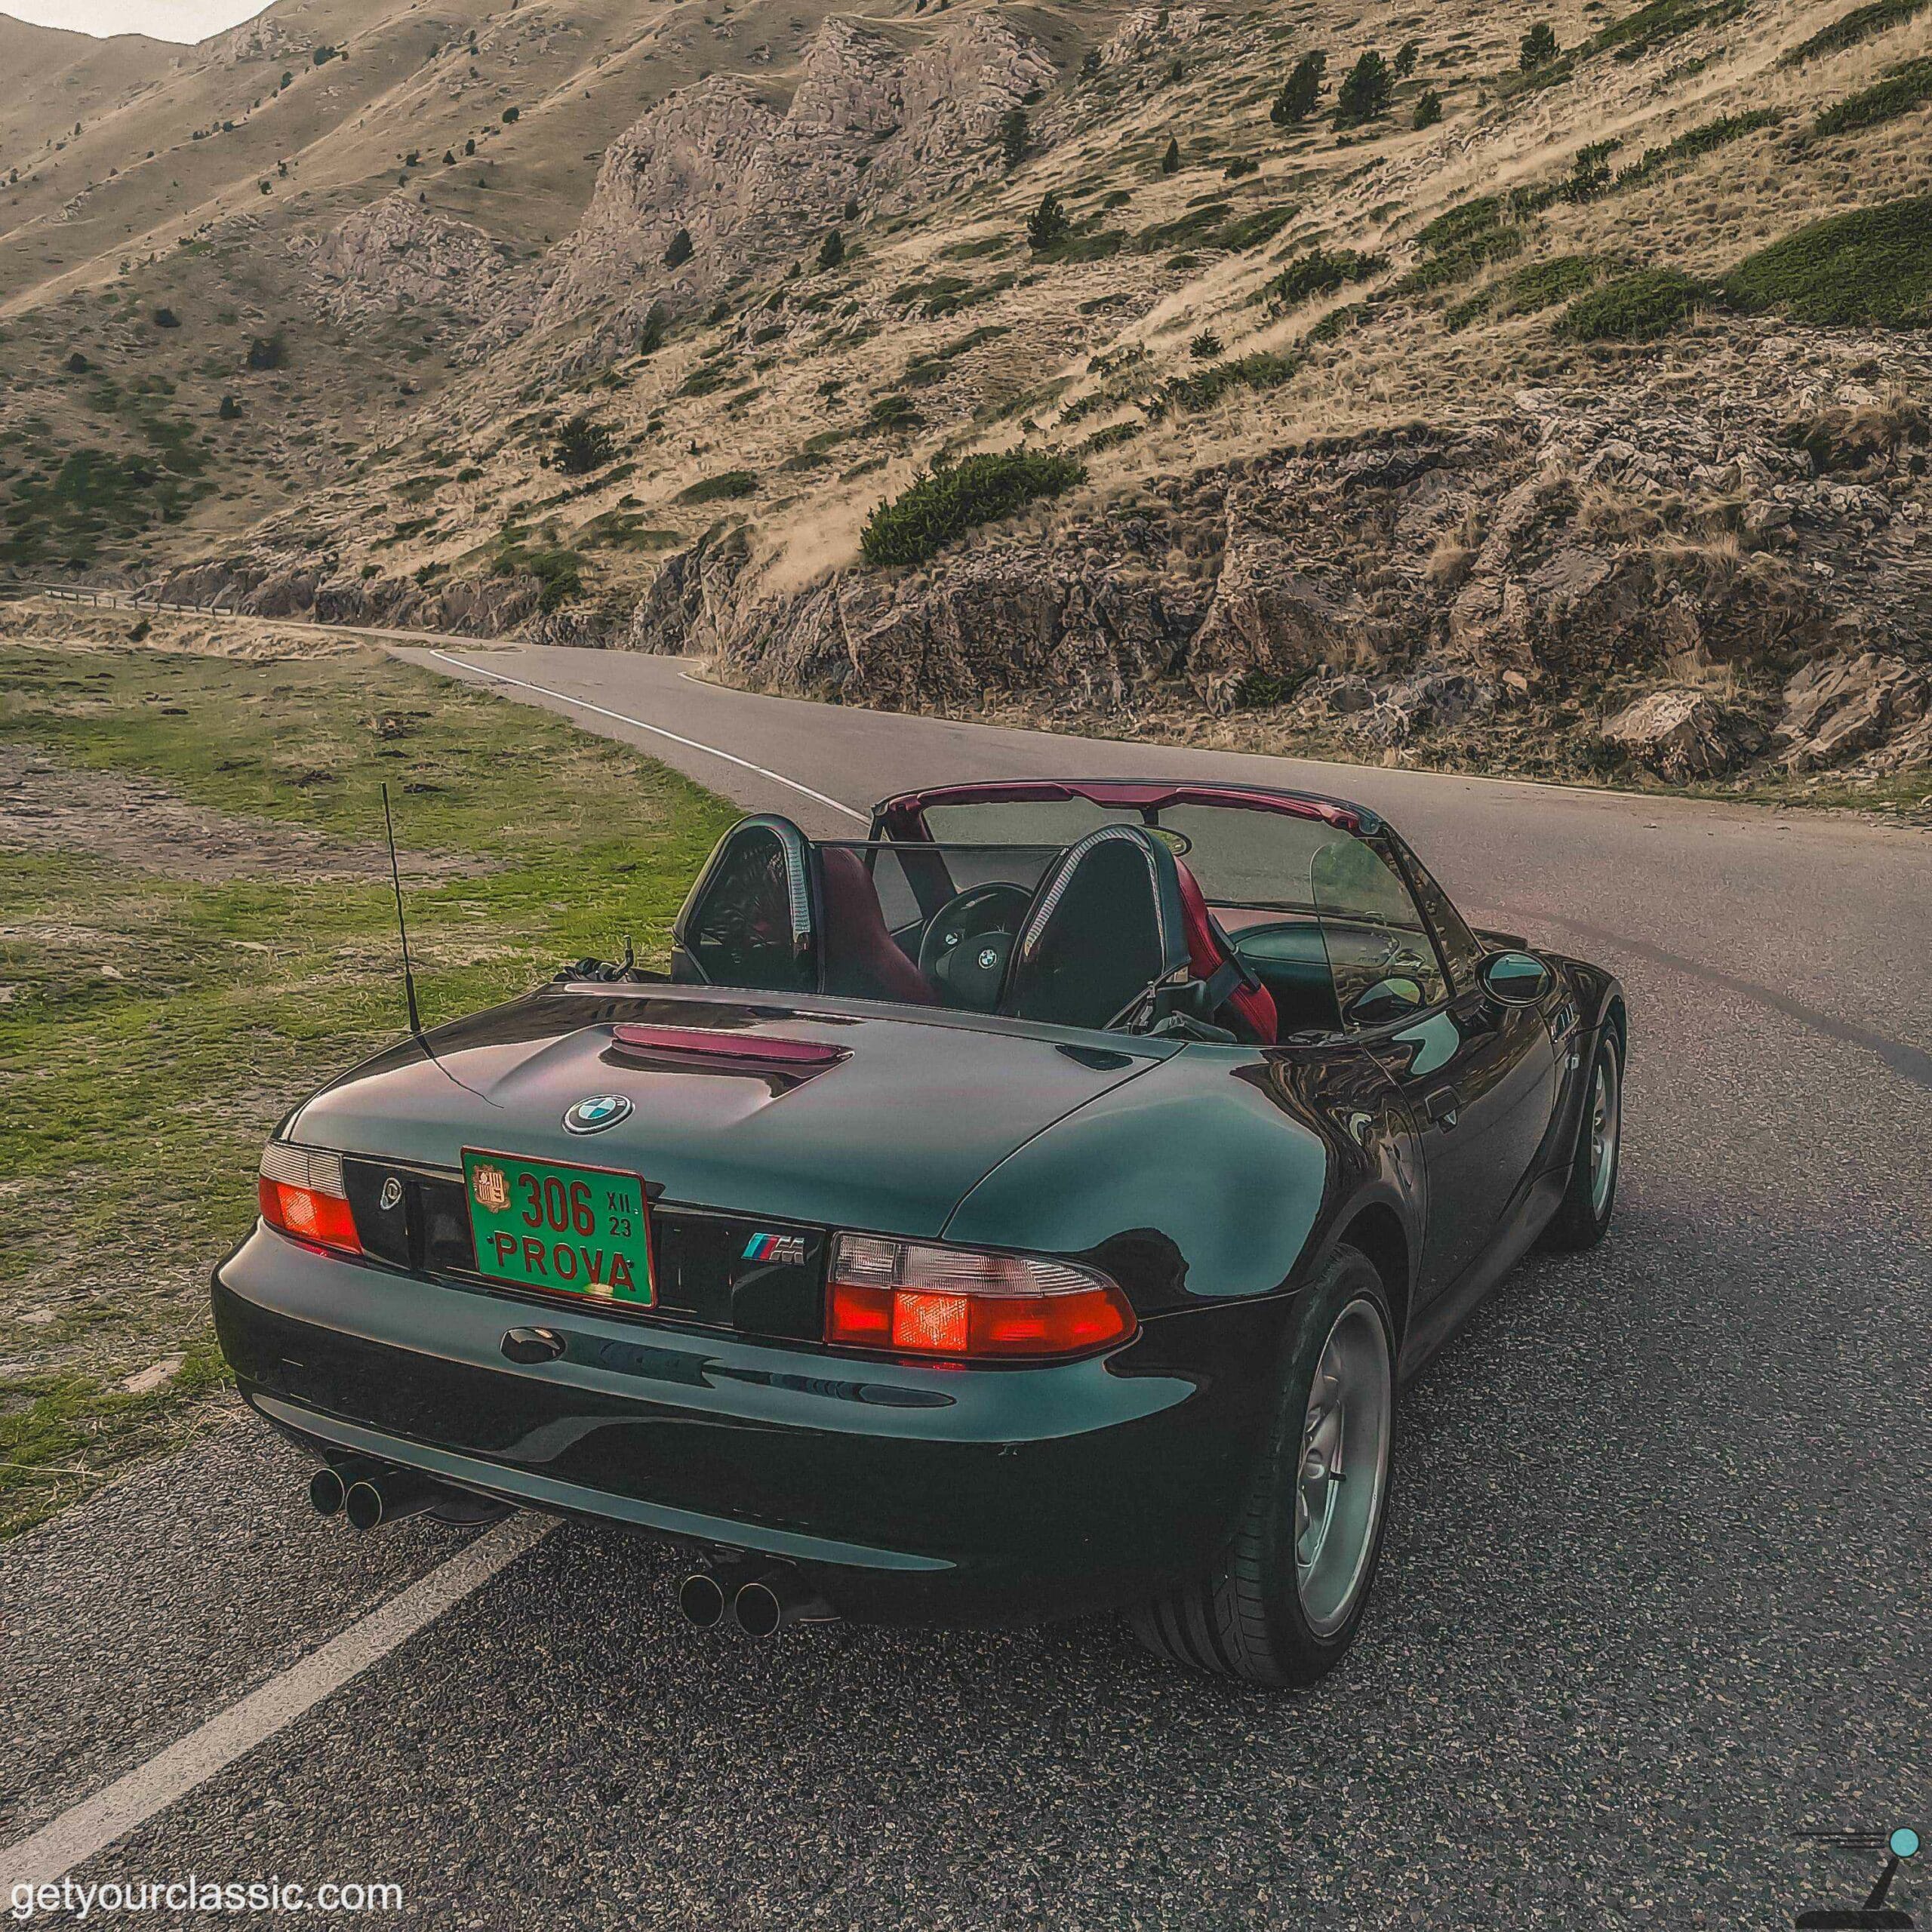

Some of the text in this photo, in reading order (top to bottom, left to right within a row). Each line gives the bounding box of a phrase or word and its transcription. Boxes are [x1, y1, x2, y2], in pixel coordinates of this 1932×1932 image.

[518, 1172, 596, 1237] 306
[606, 1190, 630, 1214] XII
[608, 1216, 632, 1238] 23
[494, 1230, 636, 1292] PROVA
